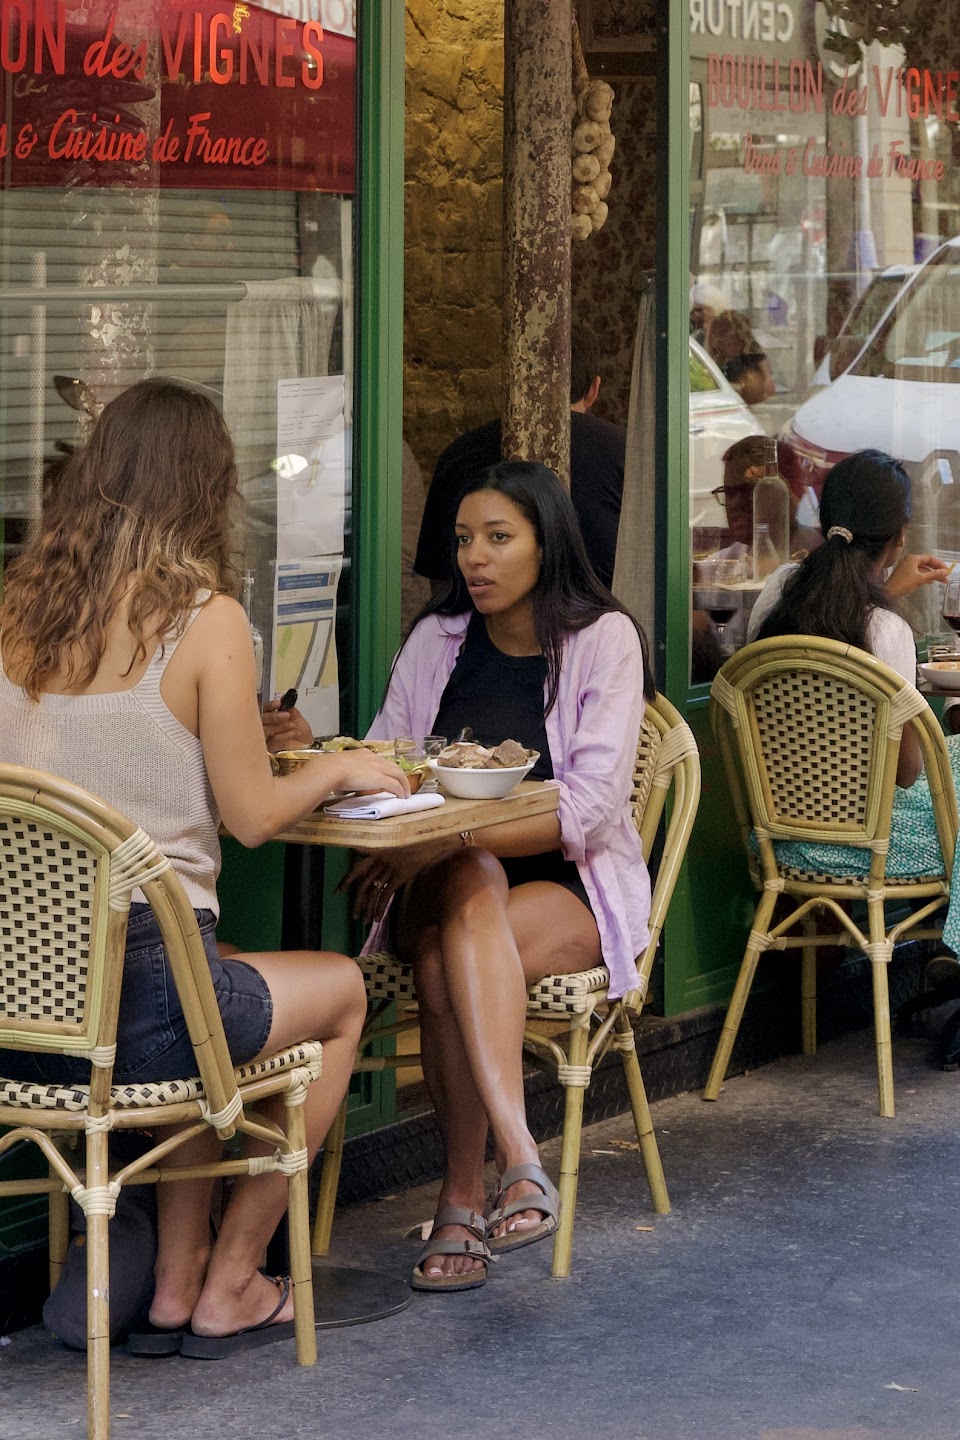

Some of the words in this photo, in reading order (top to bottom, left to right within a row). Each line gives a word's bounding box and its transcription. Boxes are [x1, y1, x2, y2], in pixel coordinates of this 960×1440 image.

[83, 4, 148, 81] des
[159, 10, 324, 90] VIGNES
[707, 52, 823, 112] BOUILLON
[48, 109, 147, 161] Cuisine
[152, 118, 181, 162] de
[183, 112, 268, 165] France
